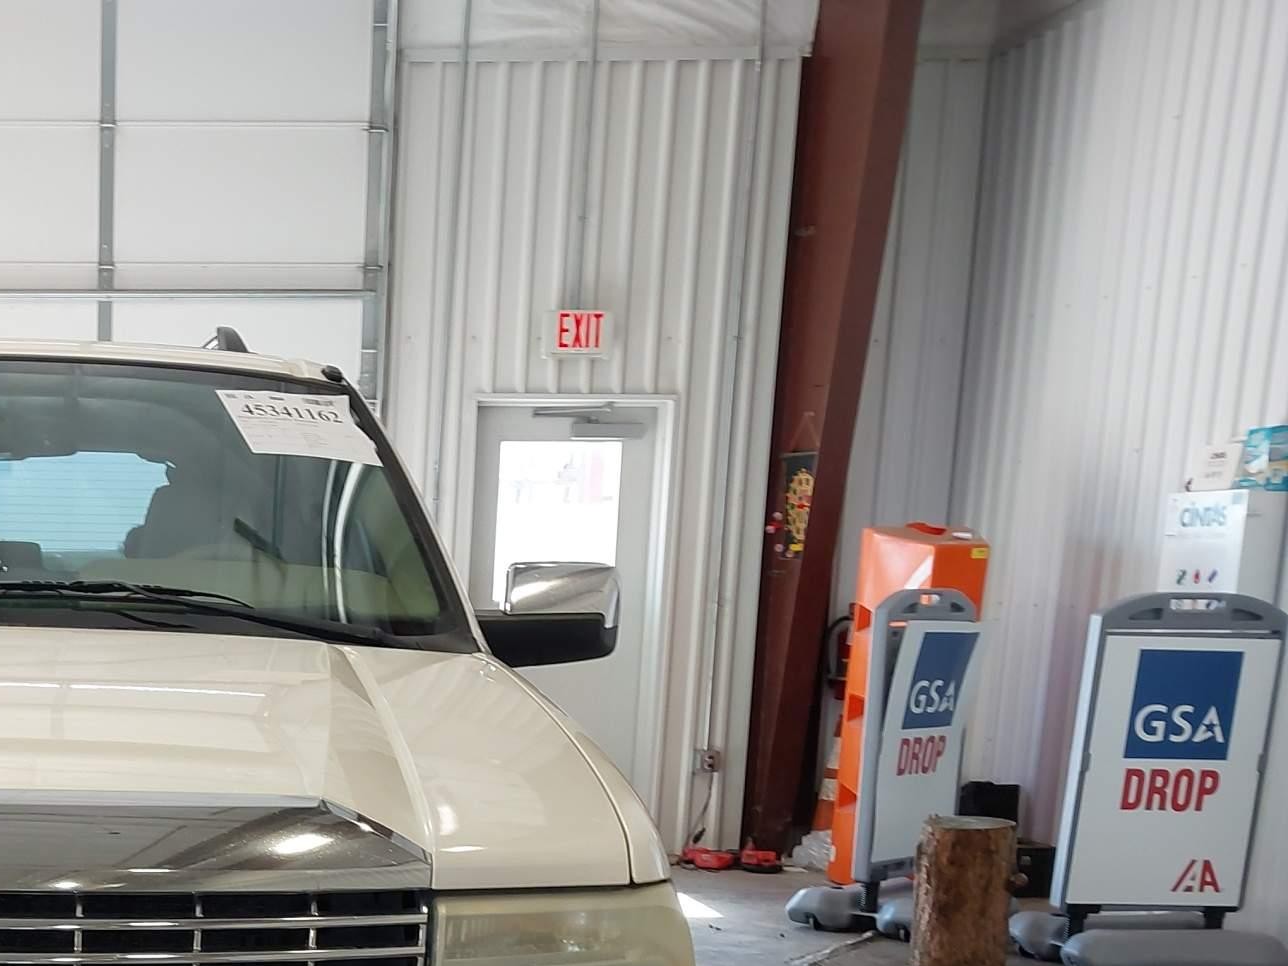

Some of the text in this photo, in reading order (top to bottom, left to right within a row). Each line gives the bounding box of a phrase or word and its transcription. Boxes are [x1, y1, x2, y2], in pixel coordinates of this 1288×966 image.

[558, 313, 604, 348] EXIT
[242, 403, 344, 424] 45341162
[910, 680, 955, 713] GSA
[1134, 704, 1225, 743] GSA
[896, 736, 946, 776] DROP
[1120, 768, 1220, 812] DROP
